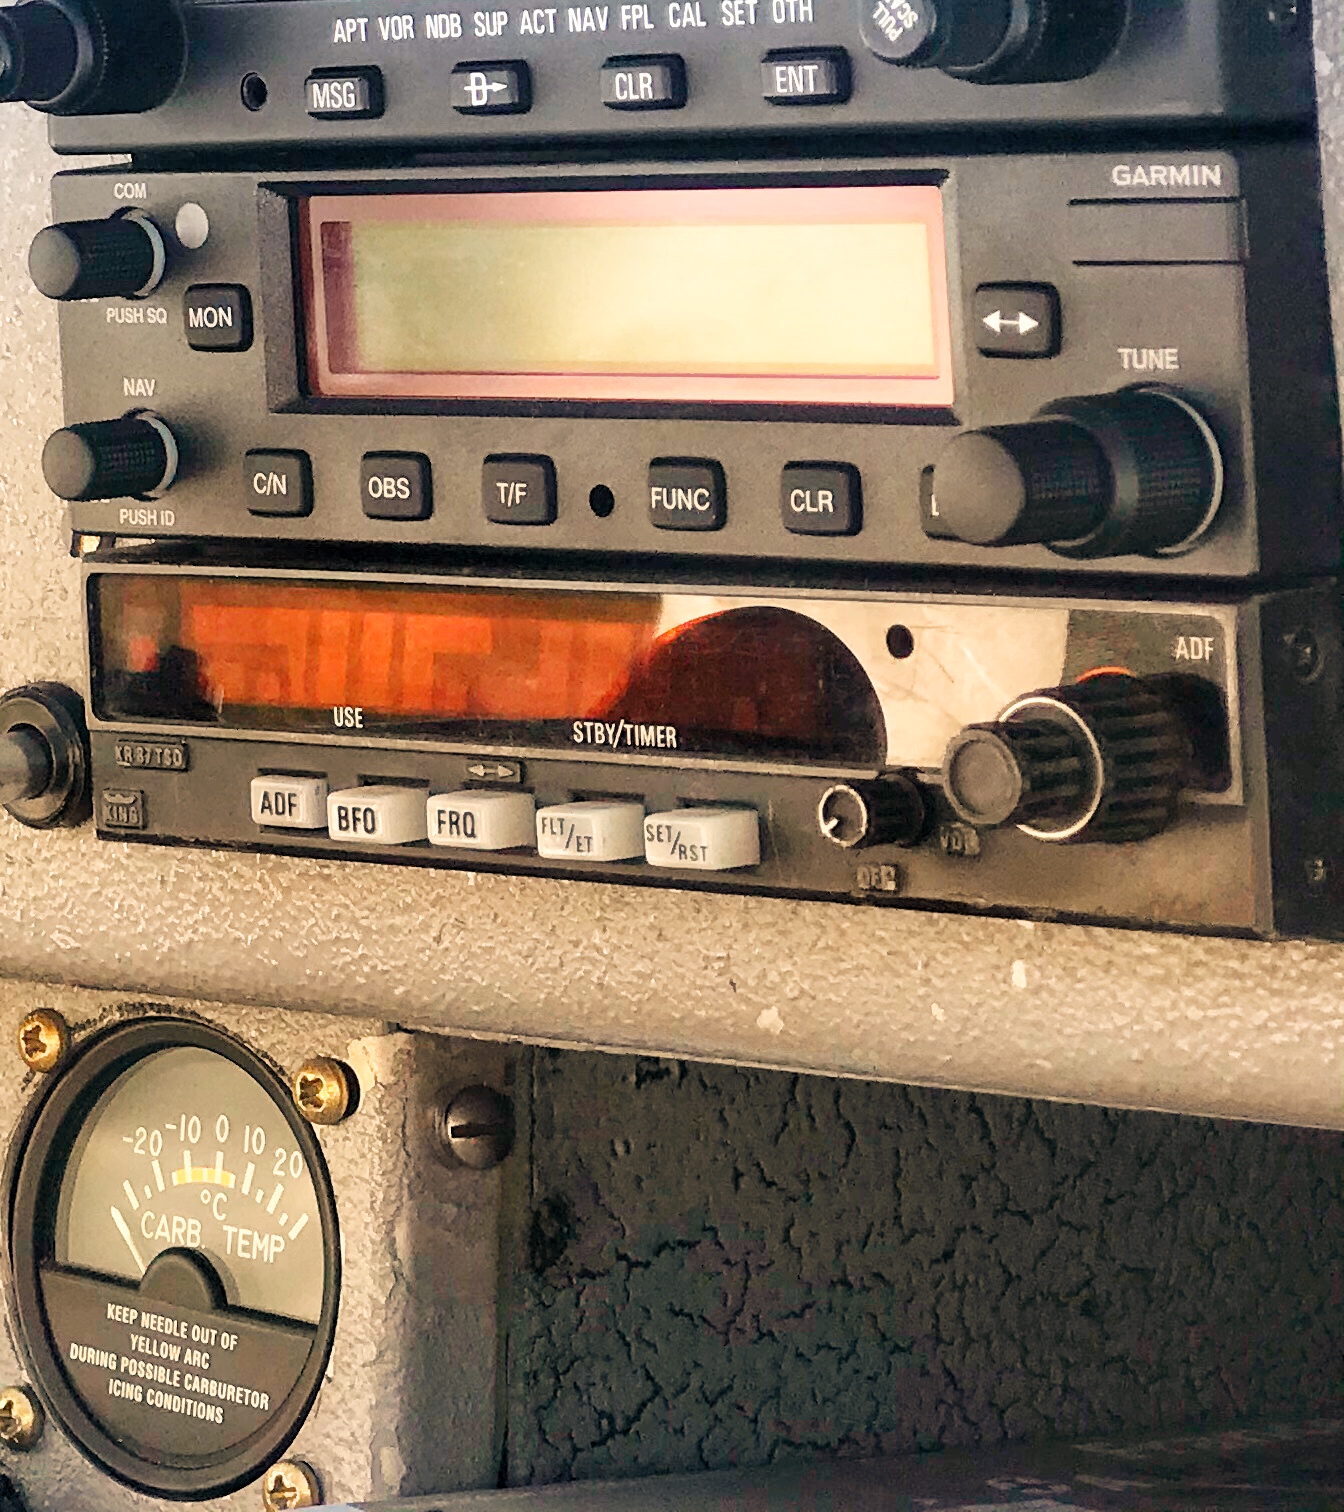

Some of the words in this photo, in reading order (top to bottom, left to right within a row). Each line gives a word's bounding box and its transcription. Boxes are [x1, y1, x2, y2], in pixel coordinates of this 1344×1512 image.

[333, 18, 368, 43] APT
[378, 15, 414, 40] VOR
[426, 13, 462, 39] NDB
[473, 11, 508, 37] SUP
[520, 9, 558, 35] ACT
[568, 7, 608, 32] NAV
[621, 4, 654, 30] FPL
[668, 2, 706, 27] CAL
[721, 0, 758, 26] SET
[615, 73, 653, 100] CLR
[775, 66, 818, 94] ENT
[313, 82, 356, 109] MSG
[1112, 164, 1221, 186] GARMIN
[114, 183, 146, 199] COM
[106, 308, 144, 324] PUSH
[147, 309, 167, 324] SQ
[189, 307, 233, 328] MON
[1118, 348, 1179, 371] TUNE
[124, 379, 155, 397] NAV
[253, 472, 287, 496] C/N
[368, 476, 410, 500] OBS
[496, 482, 527, 507] T/F
[651, 487, 710, 510] FUNC
[790, 489, 833, 512] CLR
[120, 509, 158, 525] PUSH
[161, 510, 175, 526] ID
[1176, 637, 1215, 661] ADF
[333, 707, 363, 729] USE
[573, 719, 677, 749] STBY/TIMER
[261, 791, 298, 817] ADF
[338, 806, 376, 835] BFO
[438, 810, 476, 839] FRQ
[122, 1126, 163, 1156] -20
[166, 1114, 201, 1143] -10
[216, 1115, 229, 1142] 0
[244, 1126, 266, 1154] 10
[273, 1148, 303, 1178] 20
[142, 1210, 206, 1249] CARB.
[224, 1225, 284, 1264] TEMP
[107, 1303, 138, 1325] KEEP
[141, 1312, 188, 1339] NEEDLE
[191, 1326, 217, 1346] OUT
[221, 1332, 239, 1350] OF
[130, 1334, 181, 1361] YELLOW
[184, 1349, 210, 1370] ARC
[70, 1343, 117, 1370] DURING
[121, 1358, 181, 1387] POSSIBLE
[184, 1373, 269, 1410] CARBURETOR
[109, 1379, 142, 1403] ICING
[146, 1388, 224, 1424] CONDITIONS
